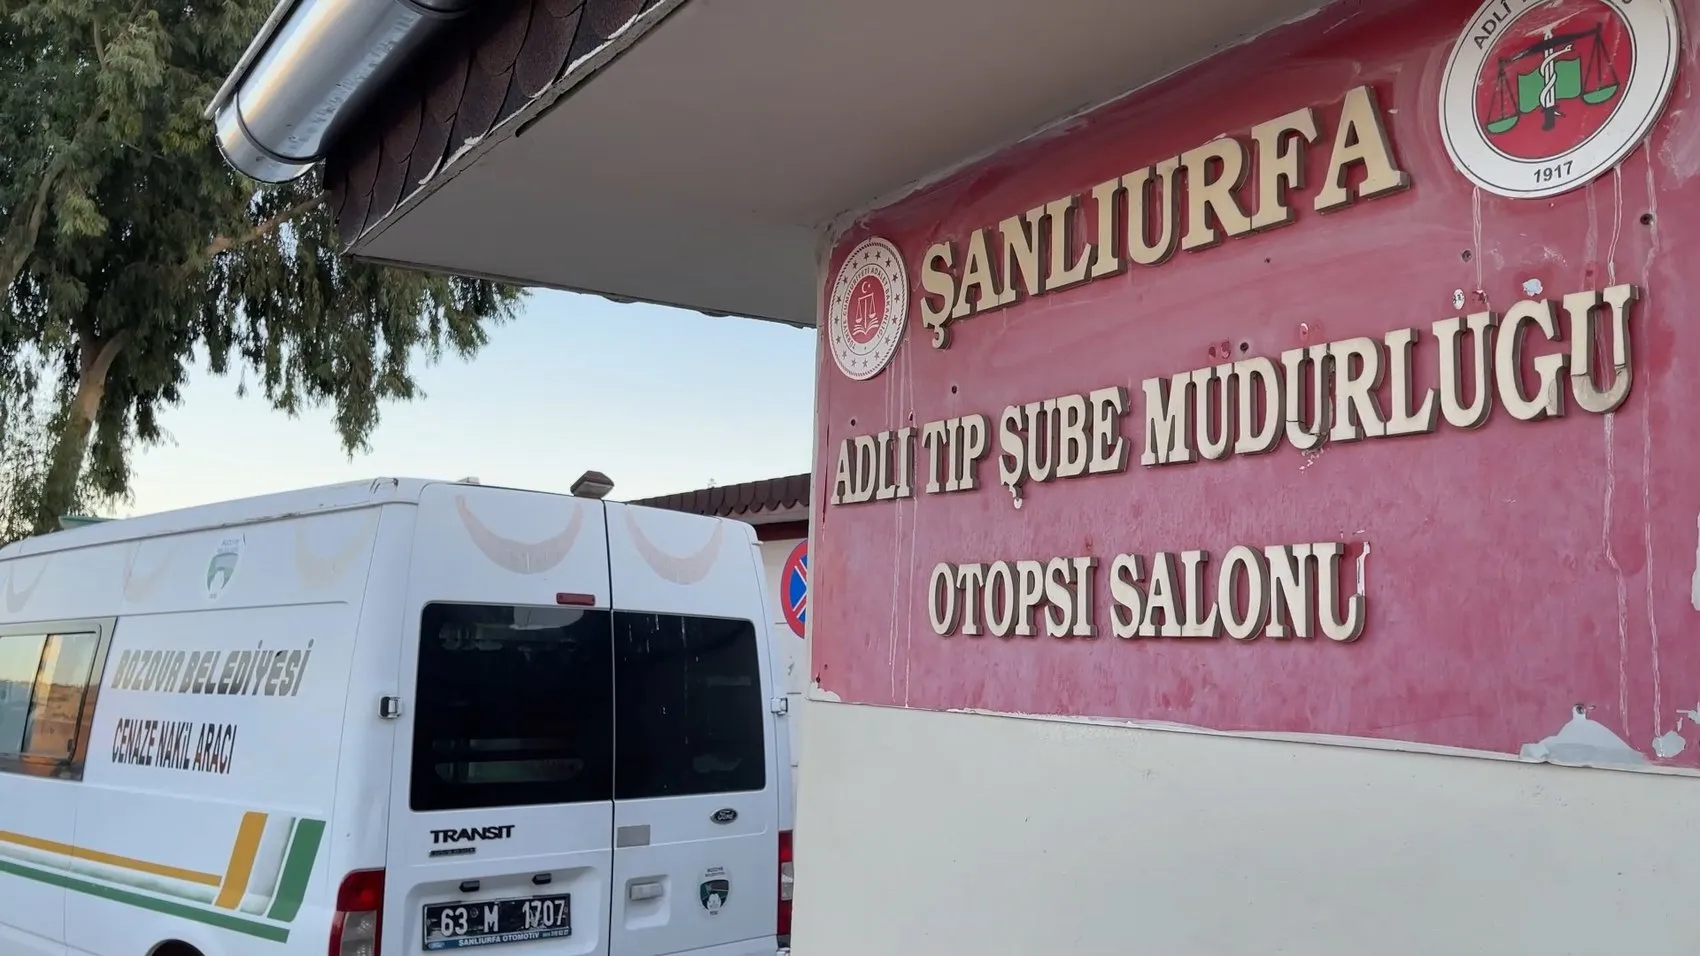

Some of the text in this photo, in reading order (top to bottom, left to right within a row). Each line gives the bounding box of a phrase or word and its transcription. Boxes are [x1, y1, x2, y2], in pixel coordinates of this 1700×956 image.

[1534, 160, 1574, 184] 1917
[919, 85, 1409, 349] ŞANLIURFA
[922, 413, 991, 494] TIP
[998, 386, 1131, 509] ŞUBE
[1110, 541, 1370, 643] SALONU
[178, 638, 315, 697] BELEDİYESİ
[112, 718, 159, 766] CENAZE
[192, 722, 238, 775] ARACI
[430, 825, 515, 844] TRANSIT
[440, 900, 566, 937] 63 M 1707
